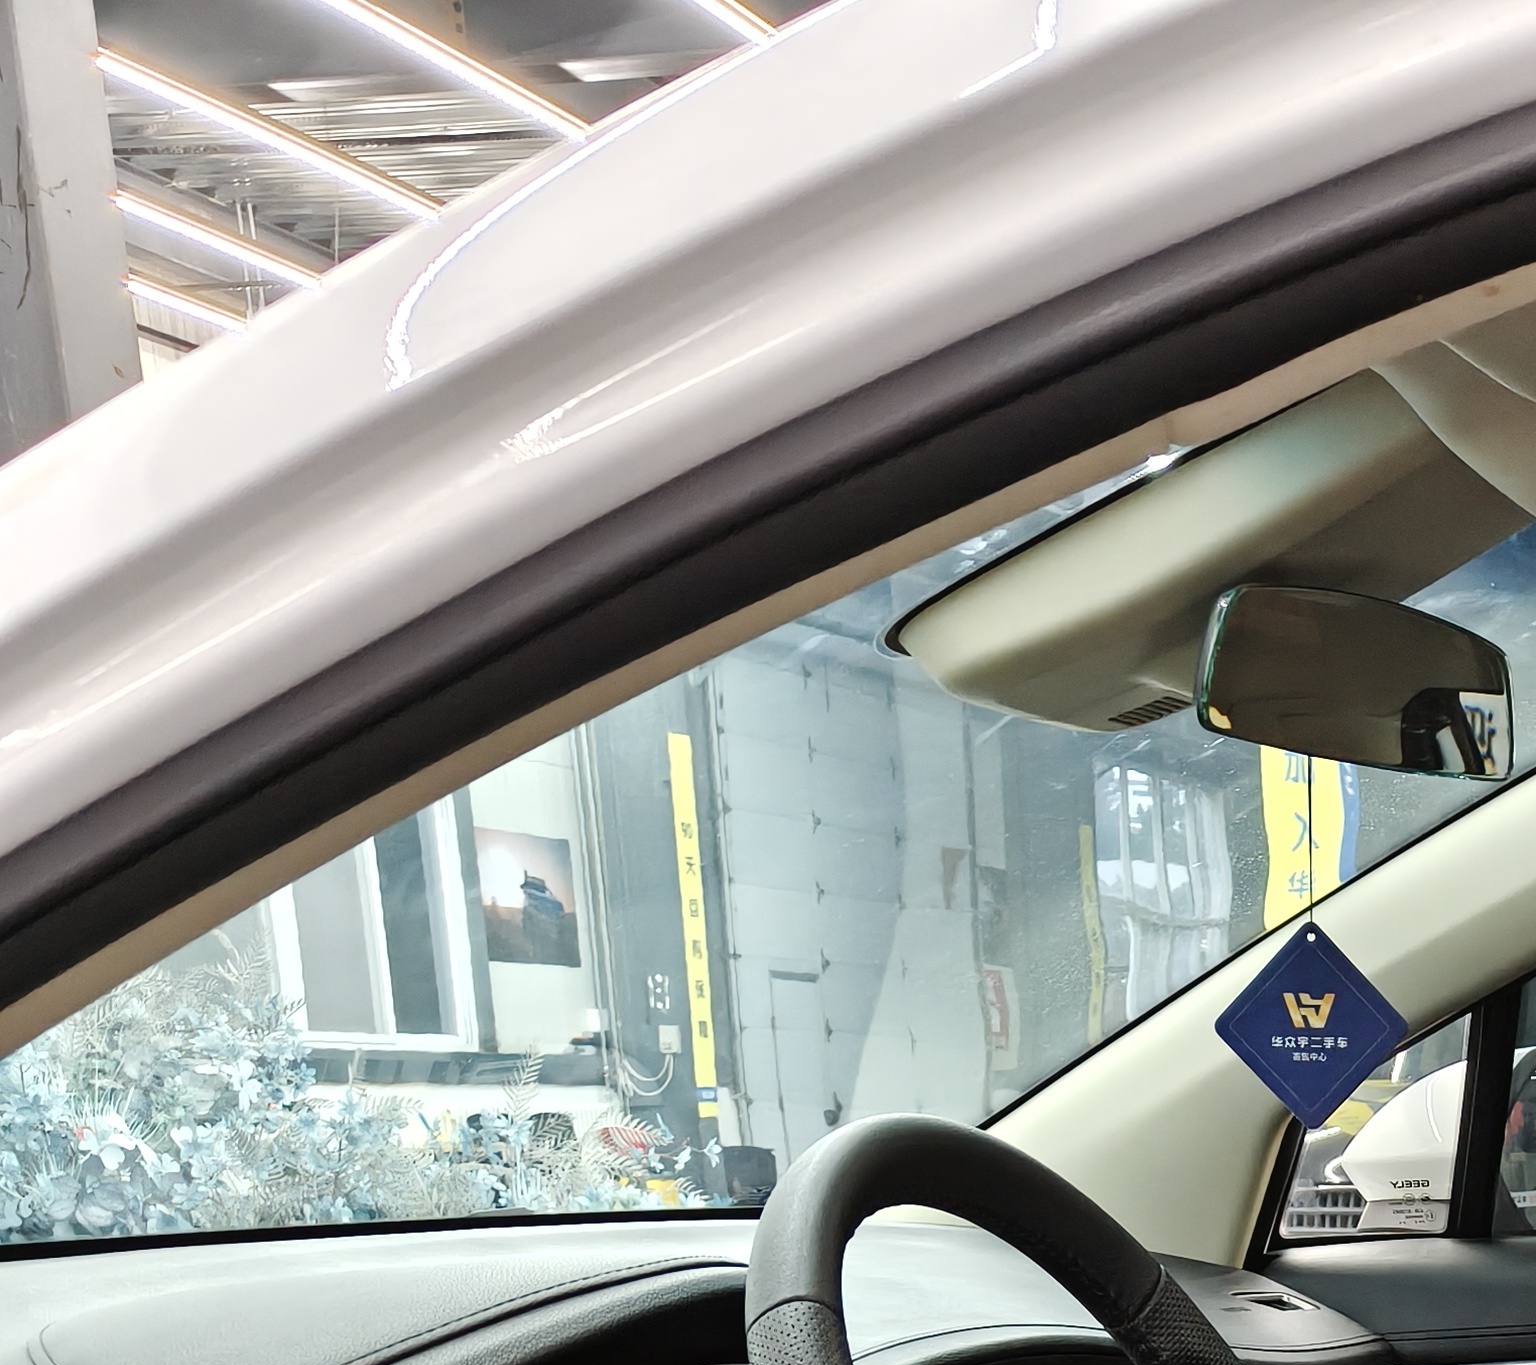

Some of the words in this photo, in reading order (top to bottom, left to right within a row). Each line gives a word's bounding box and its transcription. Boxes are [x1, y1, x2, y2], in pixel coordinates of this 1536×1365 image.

[1271, 1035, 1349, 1049] 华众宇二手车
